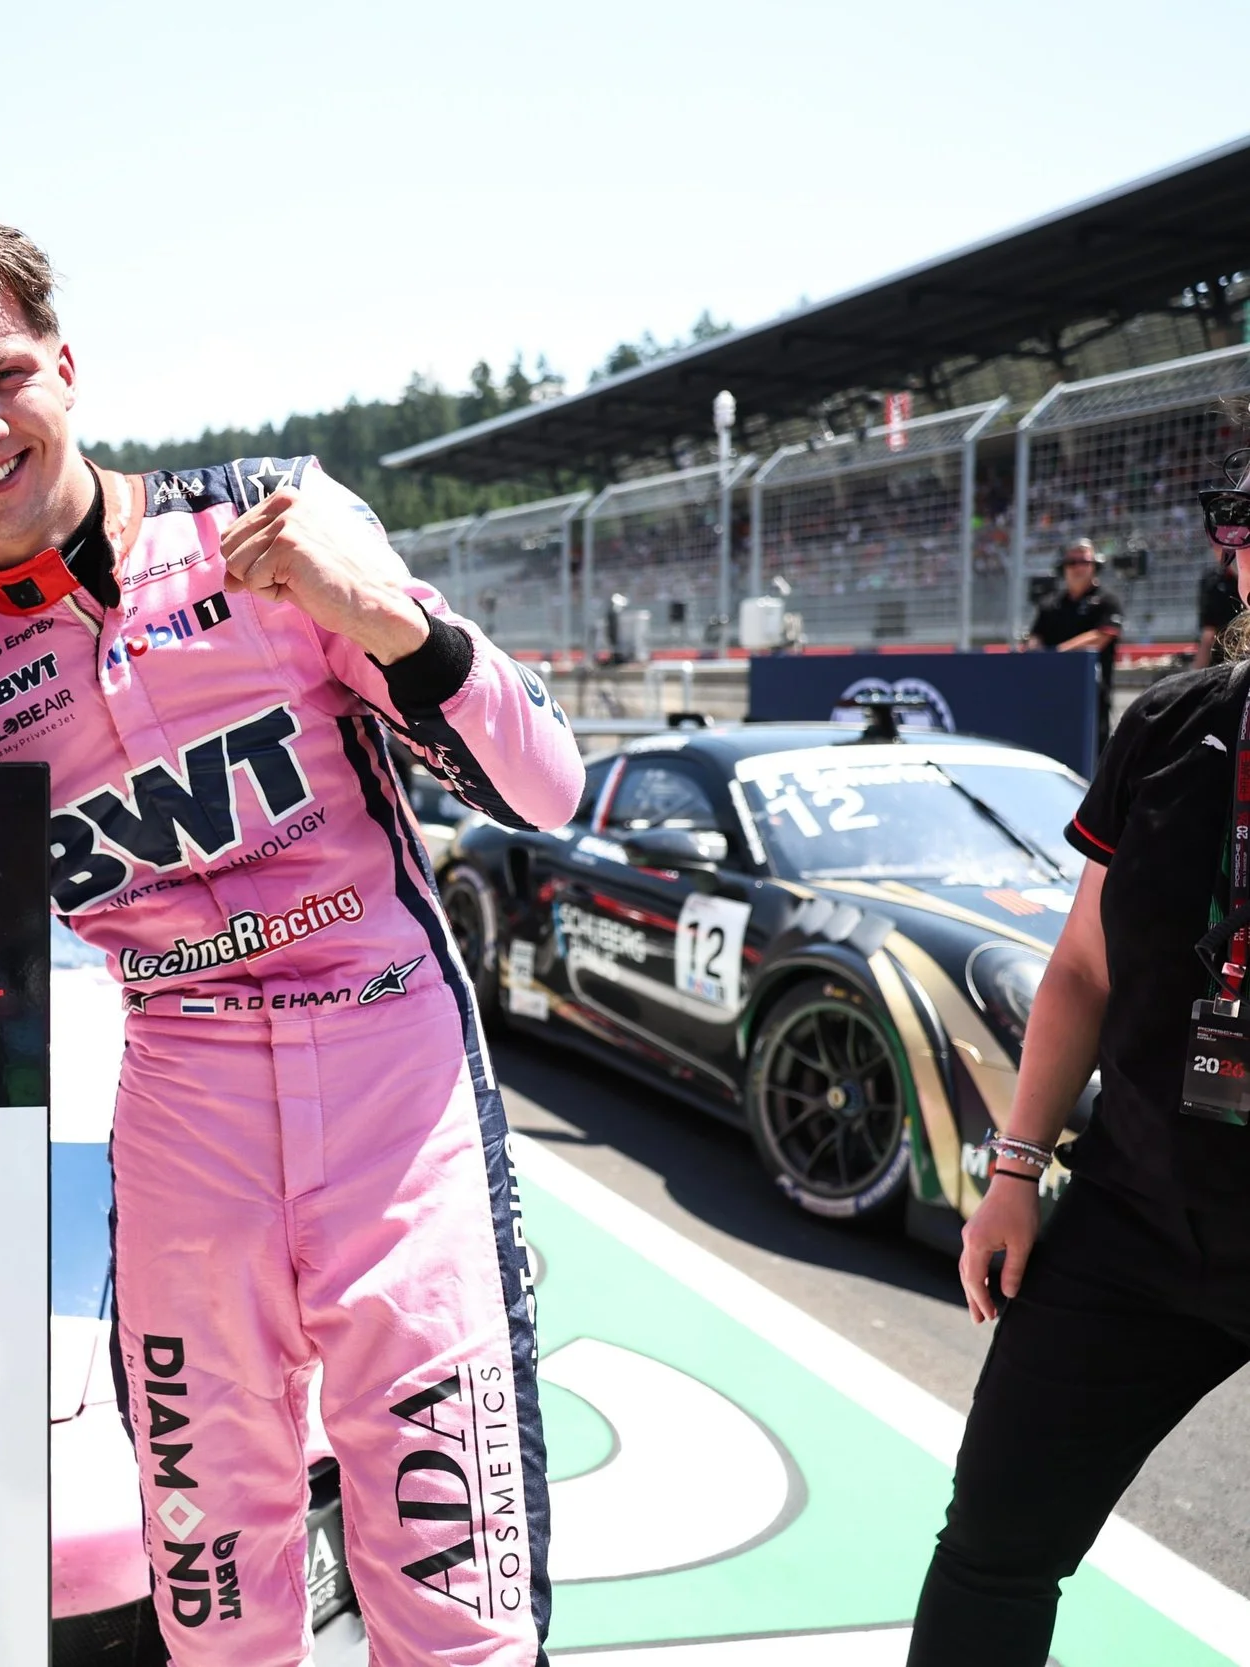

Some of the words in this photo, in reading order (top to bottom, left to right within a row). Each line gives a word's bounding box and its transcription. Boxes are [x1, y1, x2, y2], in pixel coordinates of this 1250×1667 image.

[122, 549, 201, 586] RSCHE
[4, 618, 54, 650] Energy
[203, 599, 220, 624] 1
[51, 701, 315, 916] BWT
[766, 787, 880, 838] 12
[110, 879, 184, 910] WATER
[688, 920, 725, 979] 12
[1193, 1055, 1245, 1078] 2026
[389, 1365, 481, 1619] ADA
[480, 1366, 521, 1611] COSMETICS
[215, 1560, 242, 1621] BWT
